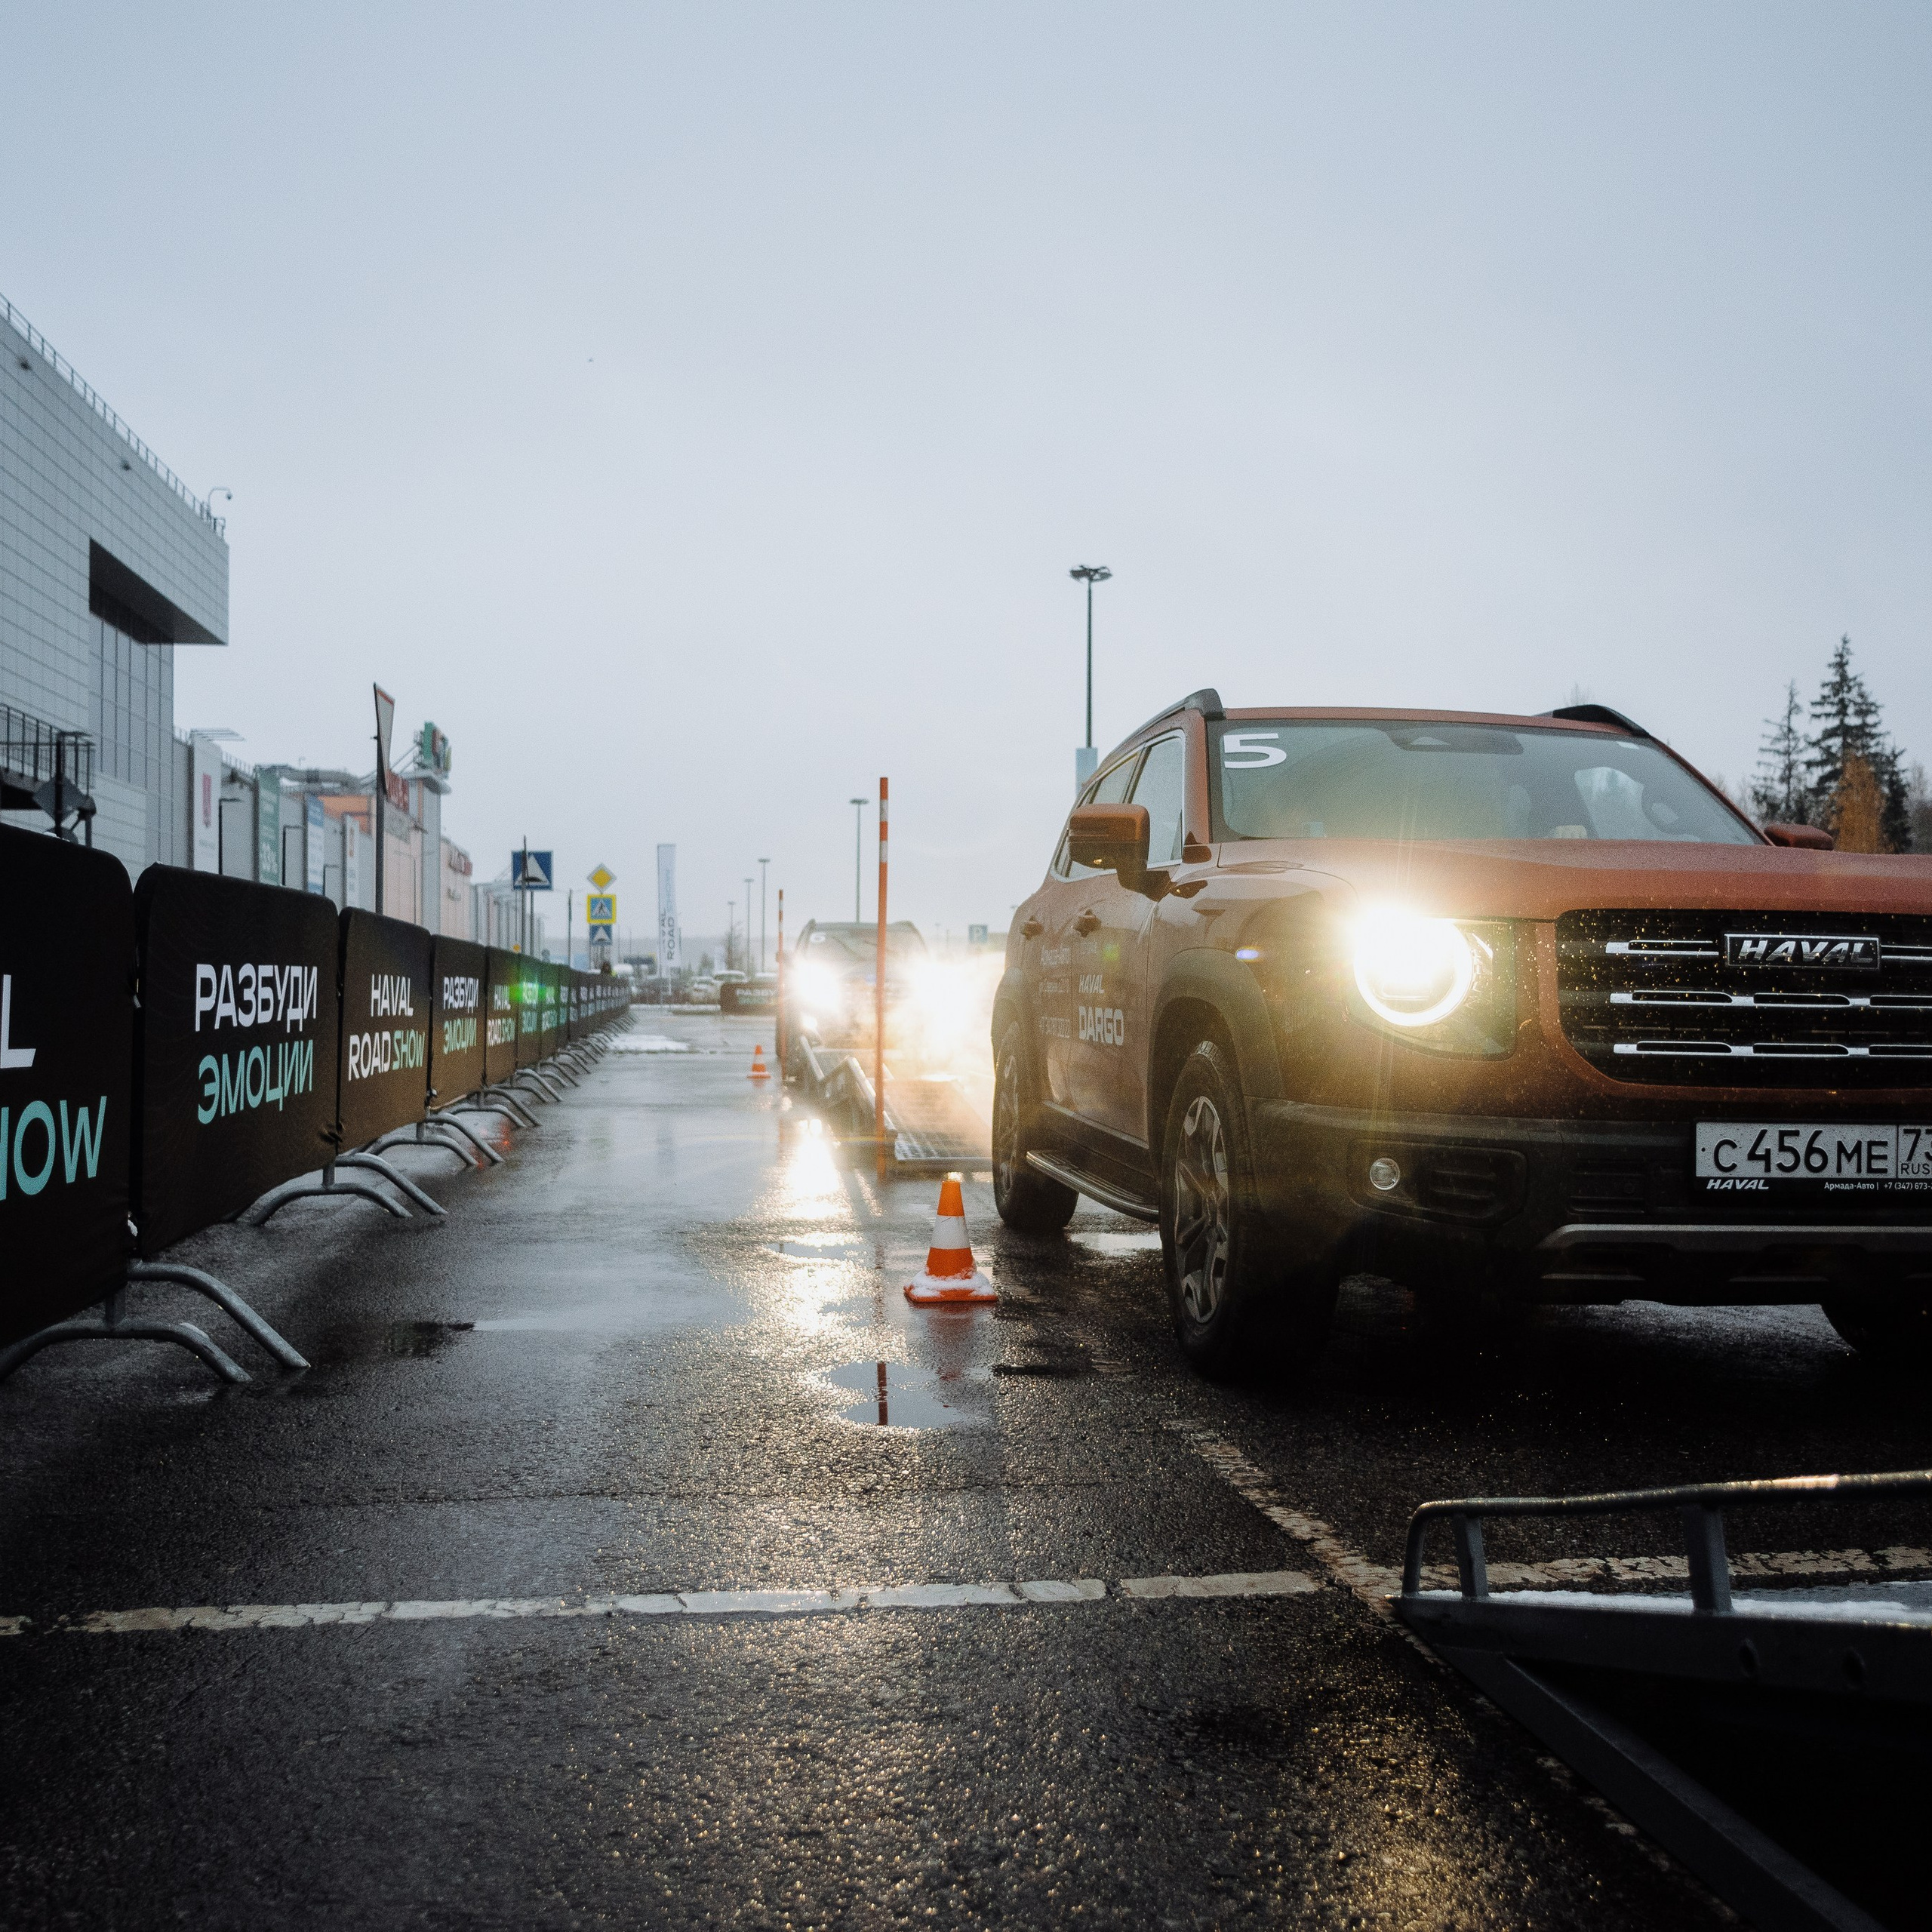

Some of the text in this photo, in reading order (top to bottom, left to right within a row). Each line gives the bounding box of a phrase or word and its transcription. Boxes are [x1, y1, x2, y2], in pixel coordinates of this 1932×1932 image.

[1223, 733, 1287, 769] 5
[667, 916, 676, 961] ROAD
[810, 932, 826, 943] 6
[1737, 939, 1875, 964] HAVAL
[195, 963, 318, 1032] РАЗБУДИ
[371, 974, 414, 1017] HAVAL
[443, 976, 479, 1014] РАЗБУДИ
[1078, 974, 1105, 994] HAVAL
[442, 1017, 477, 1055] ЭМОЦИИ
[1078, 1005, 1124, 1046] DARGO
[349, 1029, 426, 1081] ROAD SHOW
[198, 1040, 314, 1124] ЭМОЦИИ
[1706, 1179, 1770, 1190] HAVAL
[1824, 1181, 1875, 1191] Армада-Авто
[1894, 1182, 1913, 1190] (347)
[1900, 1163, 1930, 1175] RUS
